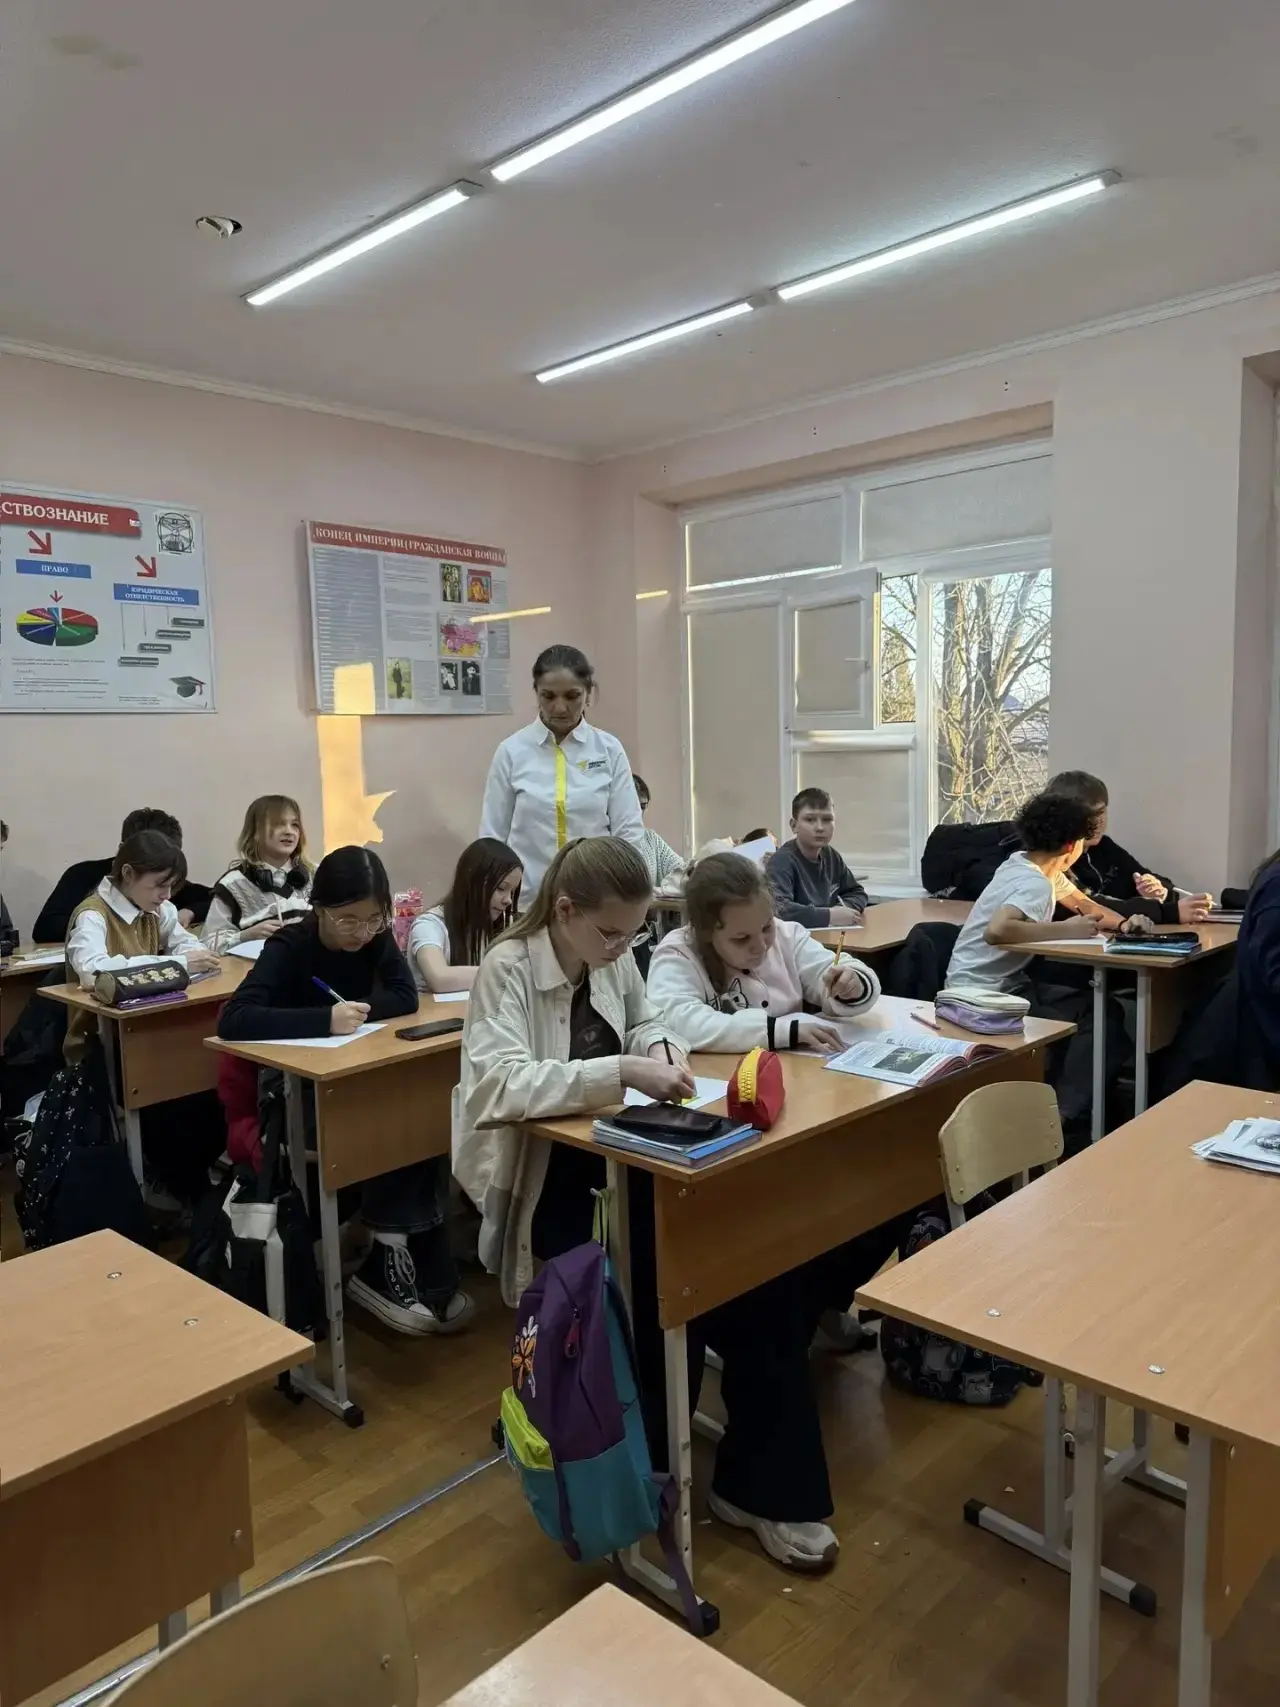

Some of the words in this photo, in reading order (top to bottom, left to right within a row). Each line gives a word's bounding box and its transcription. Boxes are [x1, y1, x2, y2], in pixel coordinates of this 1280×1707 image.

[0, 501, 109, 525] СТВОЗНАНИЕ
[315, 527, 353, 543] КОНЕЦ
[41, 564, 69, 573] ПРАВО
